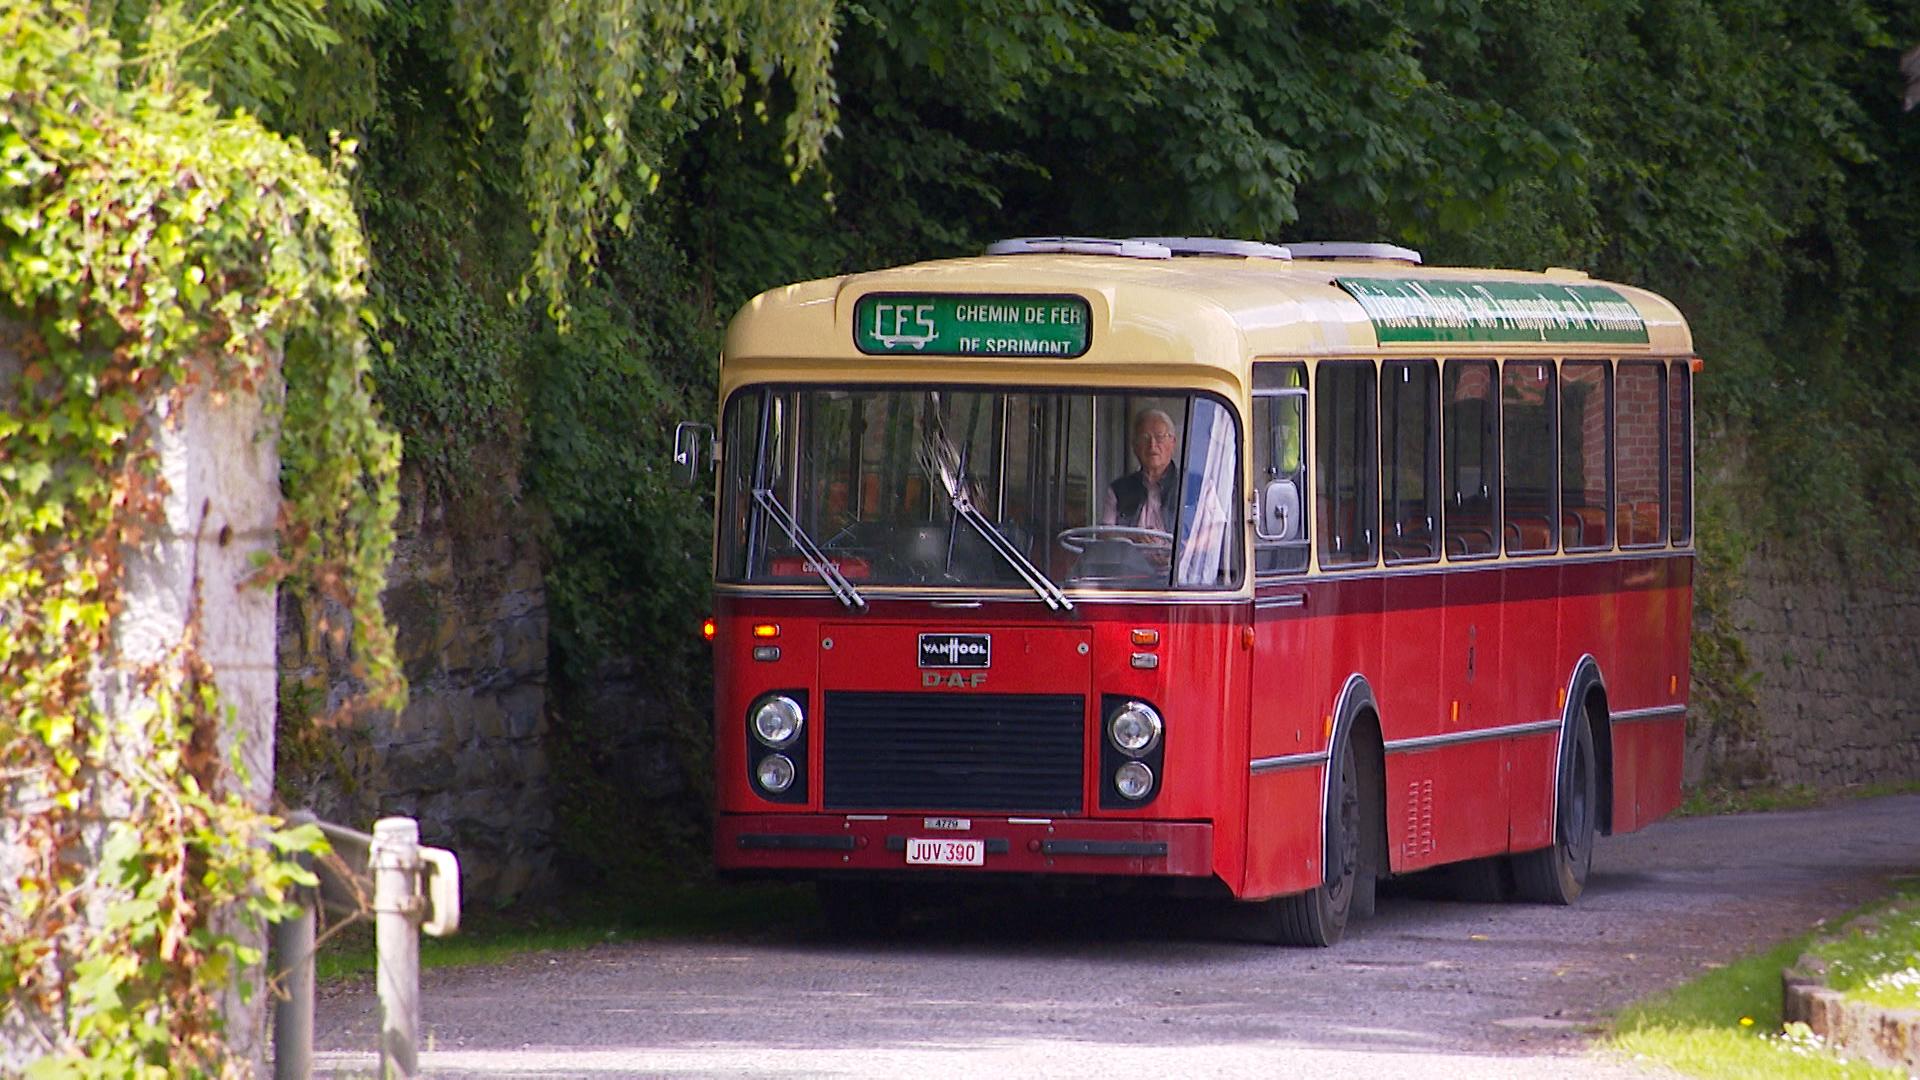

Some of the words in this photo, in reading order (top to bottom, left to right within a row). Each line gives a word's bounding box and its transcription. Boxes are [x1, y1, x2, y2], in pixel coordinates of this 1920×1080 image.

[875, 304, 935, 342] CFS
[956, 304, 1020, 323] CHEMIN
[1025, 307, 1046, 324] DE
[1050, 306, 1081, 325] FER
[1561, 299, 1588, 330] en
[1564, 287, 1644, 331] Commun
[959, 337, 981, 352] DE
[985, 338, 1073, 354] SPRIMONT
